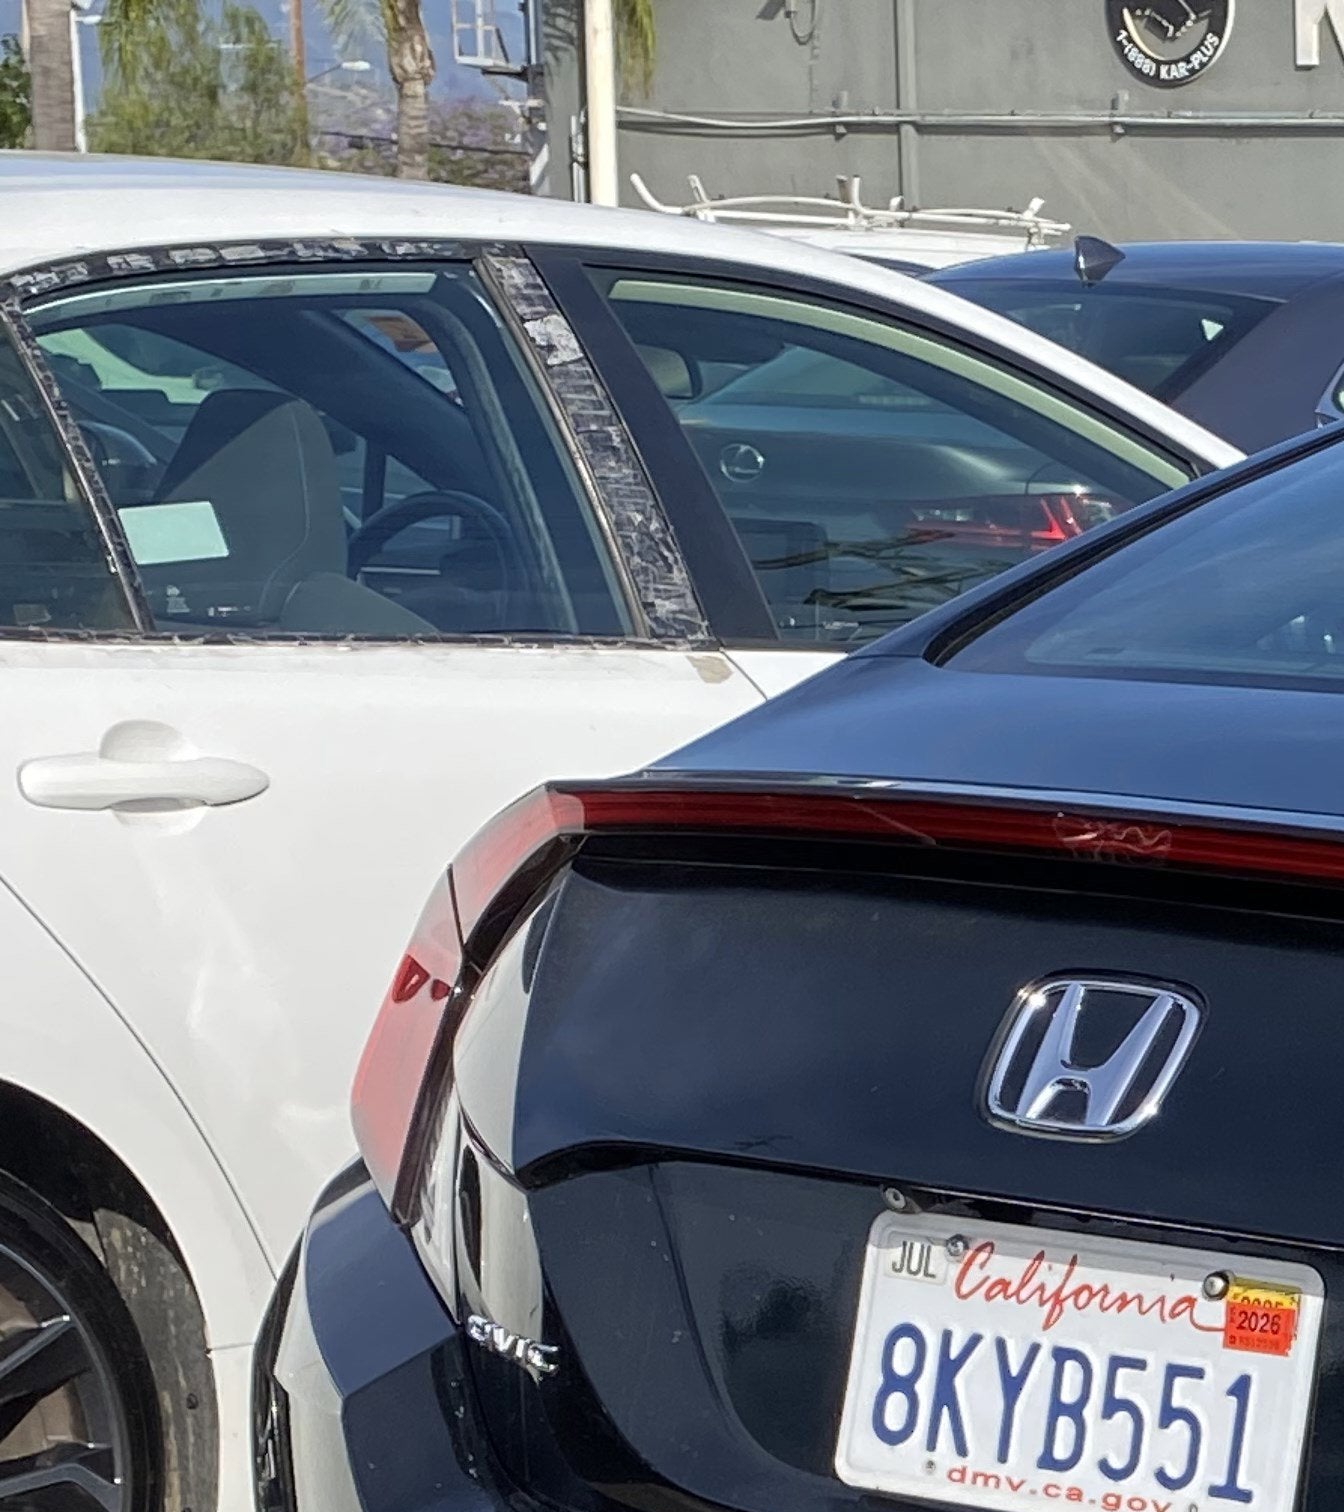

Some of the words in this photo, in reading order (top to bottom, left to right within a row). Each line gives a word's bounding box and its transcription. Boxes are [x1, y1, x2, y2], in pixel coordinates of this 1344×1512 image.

[1159, 32, 1220, 79] KAR-PLUS
[891, 1241, 937, 1280] JUL
[954, 1240, 1226, 1332] California
[1236, 1310, 1281, 1335] 2026
[871, 1321, 1254, 1504] 8KYB551
